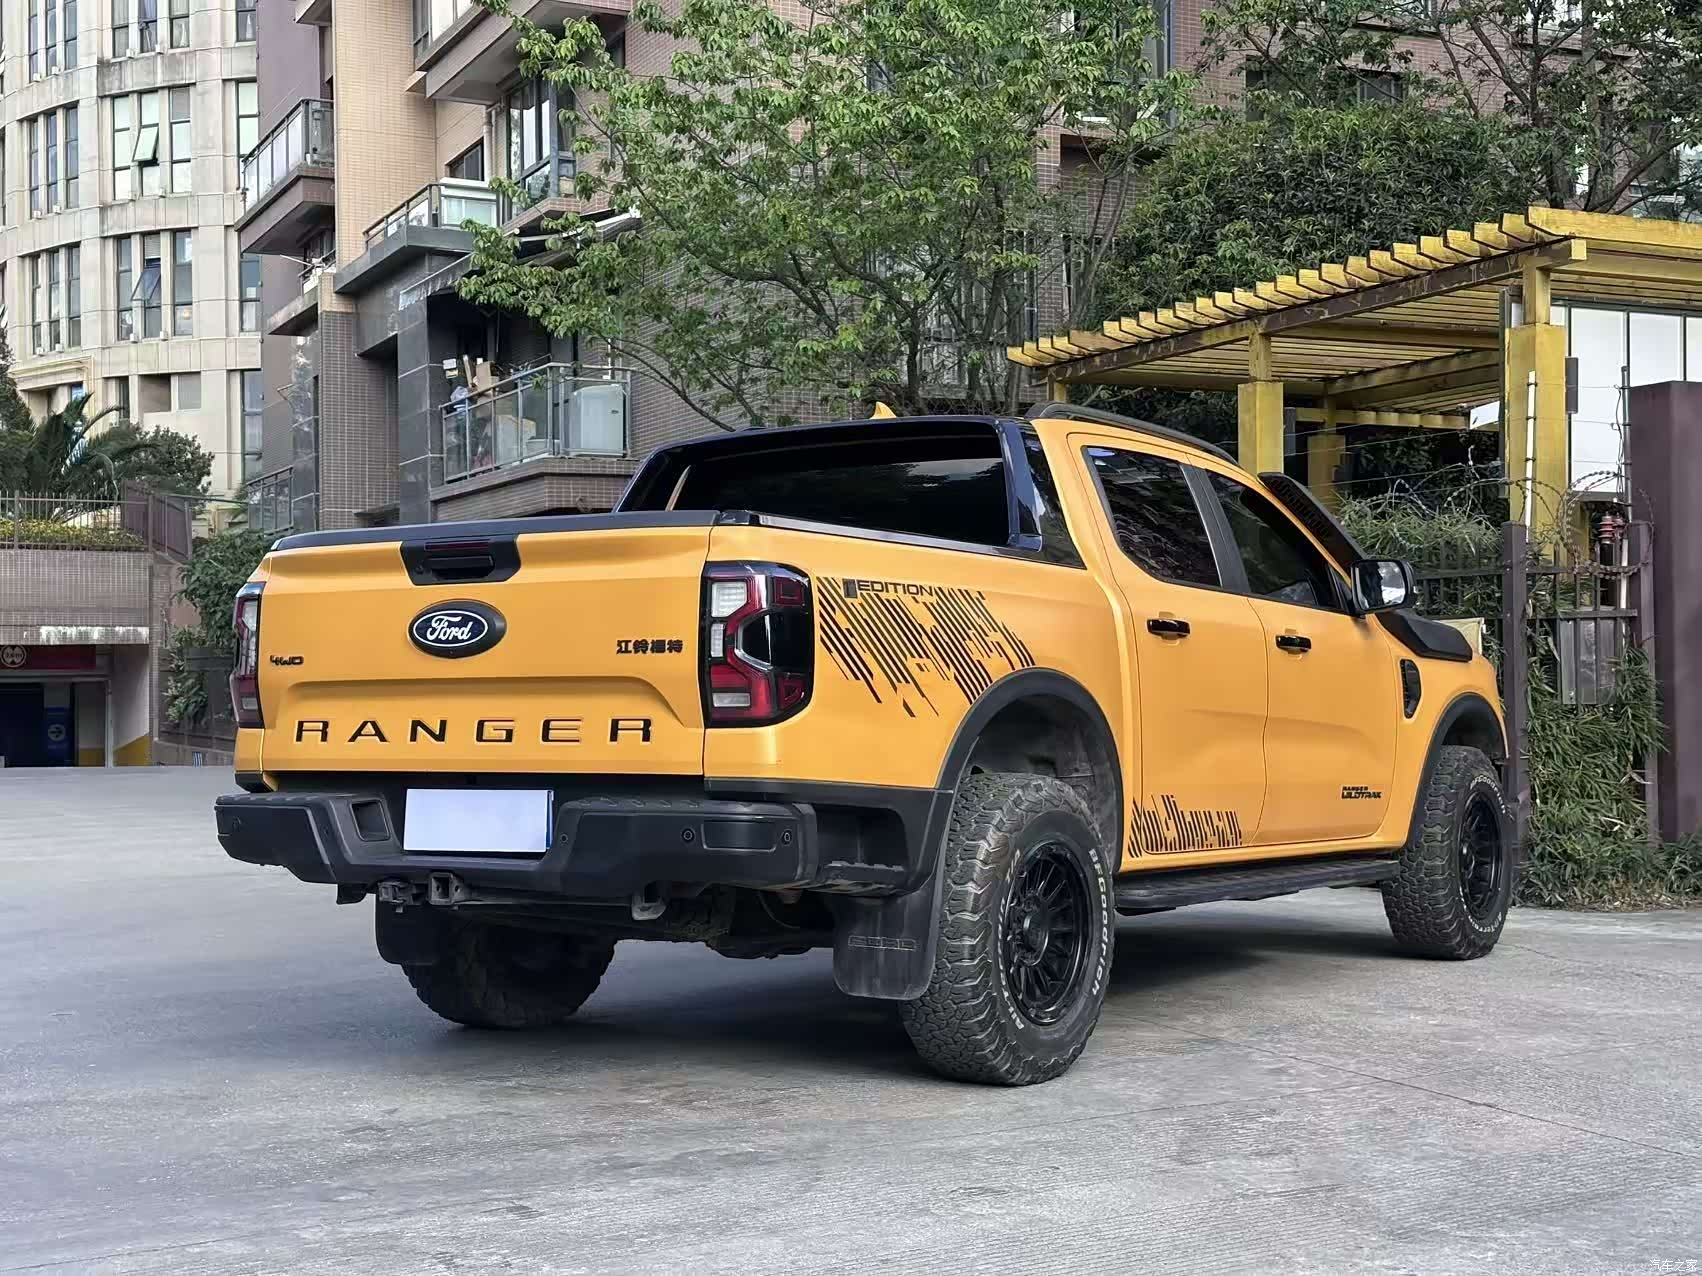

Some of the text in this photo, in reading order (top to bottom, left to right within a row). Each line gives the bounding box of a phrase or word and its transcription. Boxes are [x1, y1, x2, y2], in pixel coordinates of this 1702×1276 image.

[857, 580, 933, 596] EDITION
[426, 615, 474, 641] Ford
[616, 639, 683, 654] 江铃福特
[295, 718, 652, 743] RANGER
[1088, 848, 1109, 996] BFGoodrich
